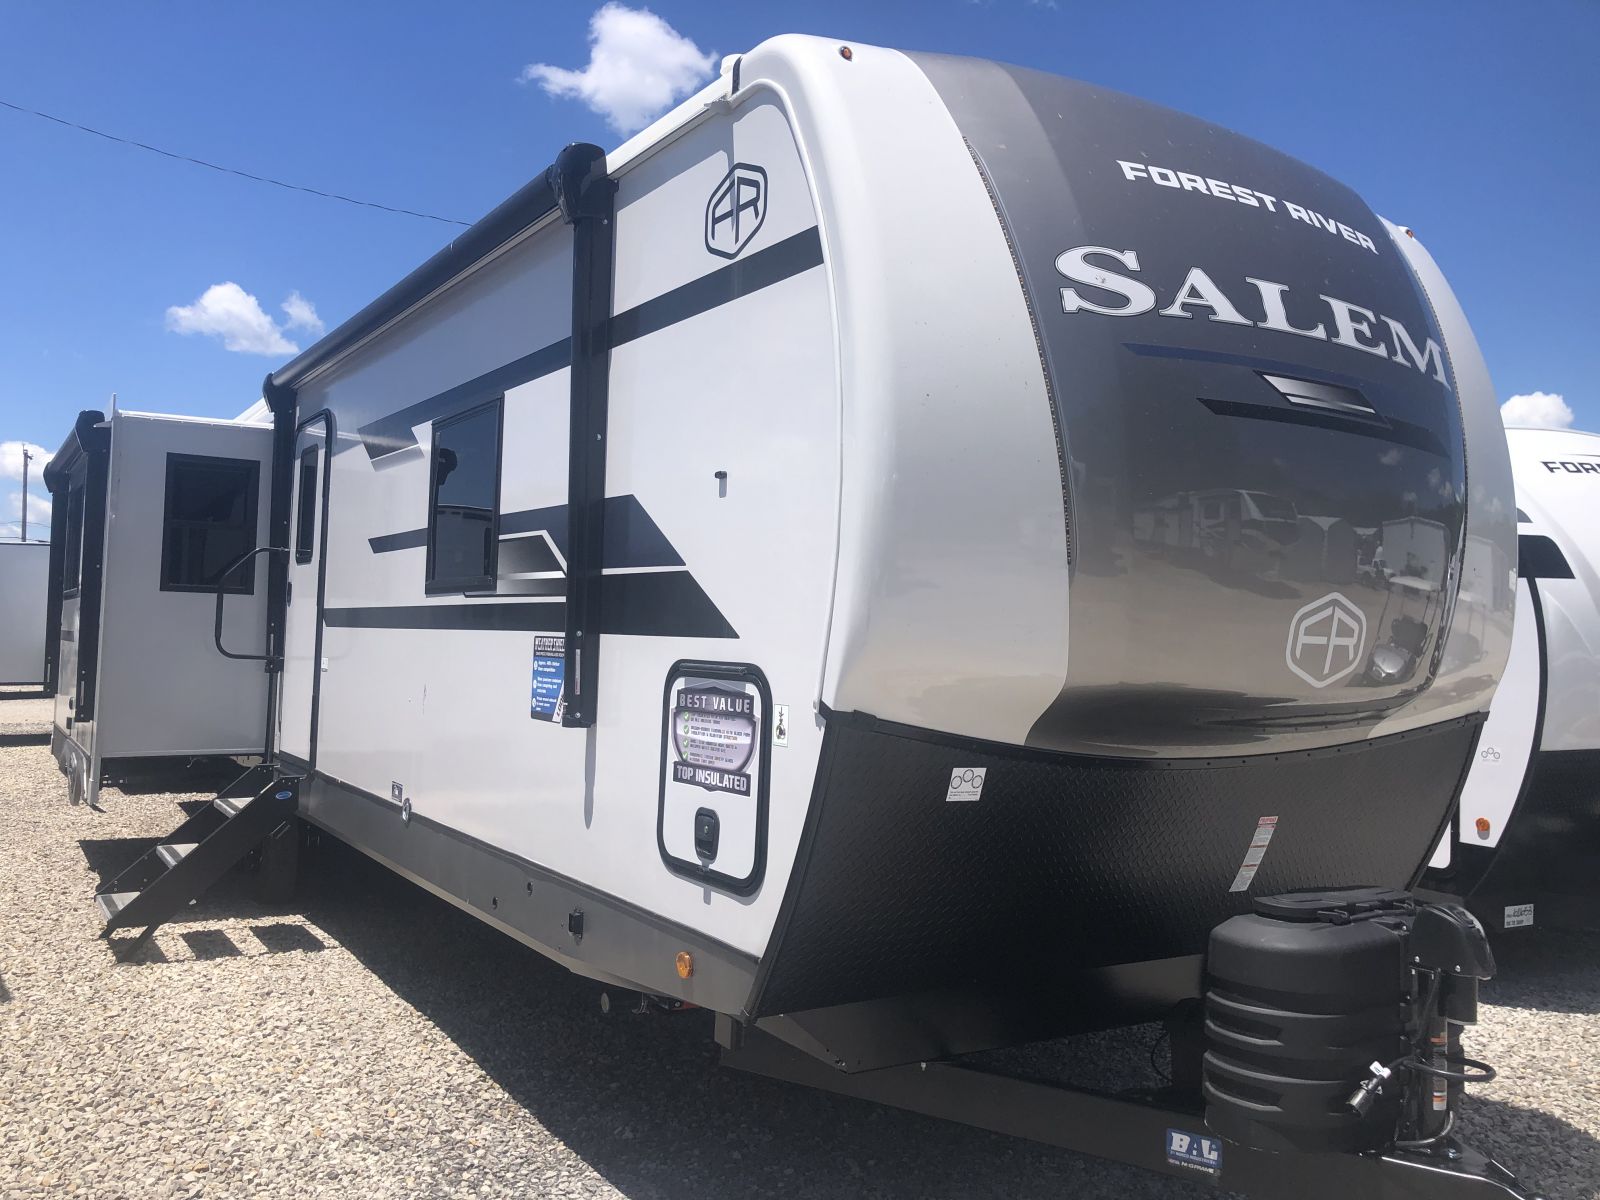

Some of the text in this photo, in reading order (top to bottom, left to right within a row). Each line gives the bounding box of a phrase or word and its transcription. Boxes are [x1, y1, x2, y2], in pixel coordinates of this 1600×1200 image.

[1116, 160, 1379, 255] FOREST RIVER
[1054, 245, 1452, 391] SALEM
[680, 693, 750, 713] BEST VALUE
[677, 765, 747, 791] TOP INSULATED
